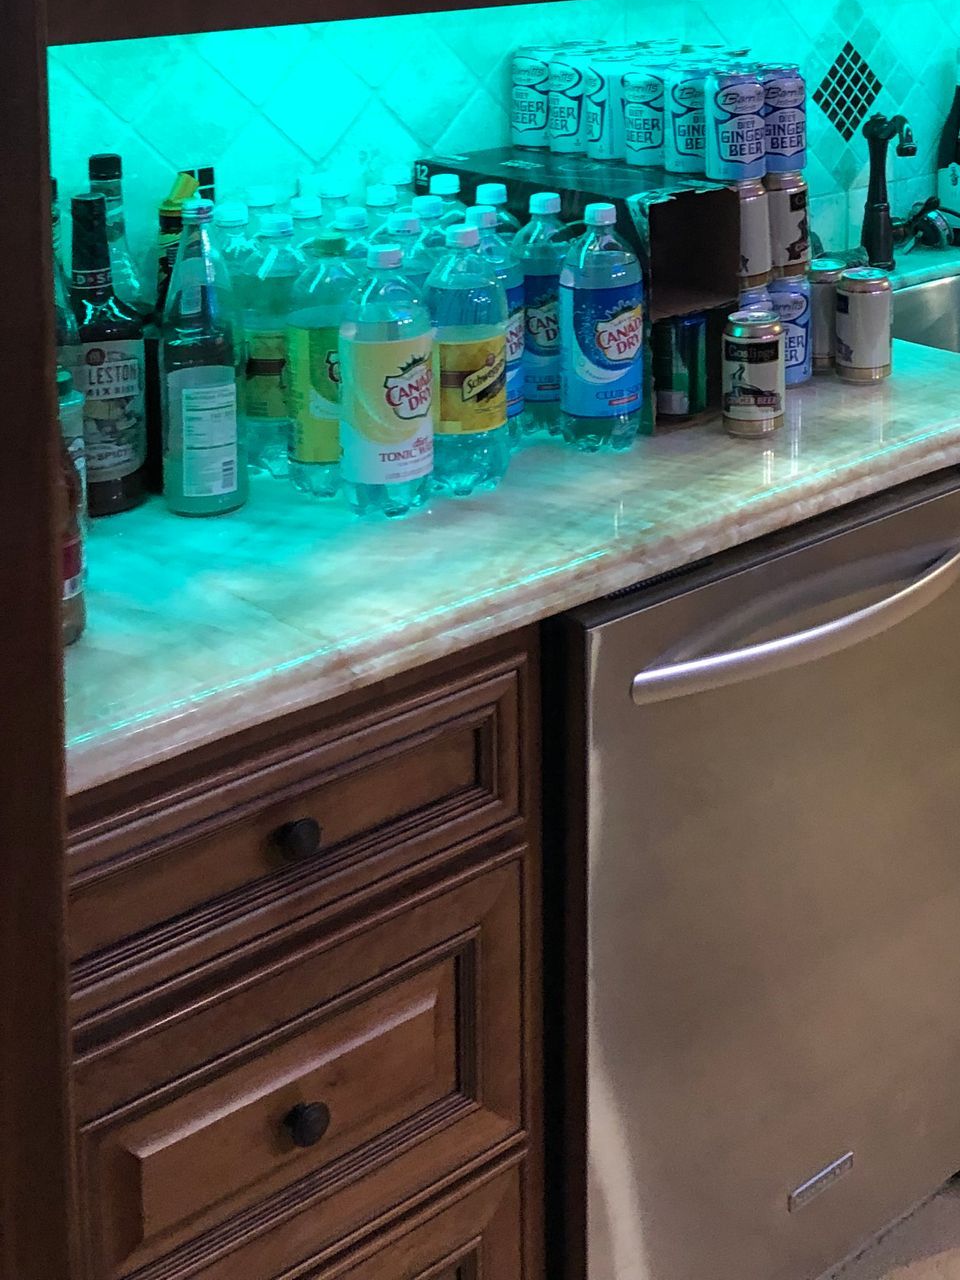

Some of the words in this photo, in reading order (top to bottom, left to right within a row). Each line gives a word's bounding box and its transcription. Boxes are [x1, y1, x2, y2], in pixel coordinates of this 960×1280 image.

[728, 141, 763, 157] BEER
[770, 134, 804, 150] BEER
[416, 164, 429, 181] 12
[379, 447, 417, 463] TONIC
